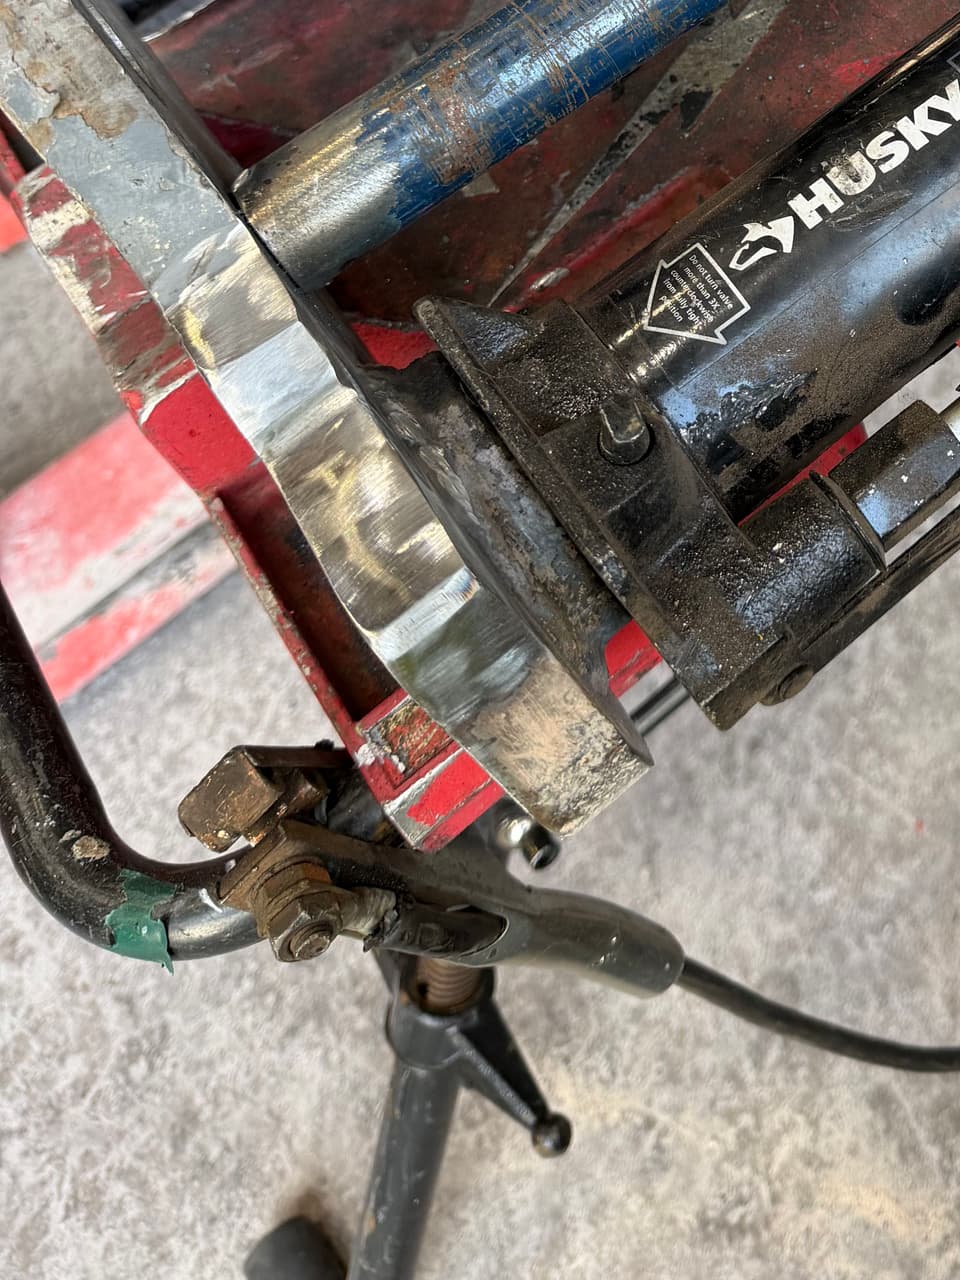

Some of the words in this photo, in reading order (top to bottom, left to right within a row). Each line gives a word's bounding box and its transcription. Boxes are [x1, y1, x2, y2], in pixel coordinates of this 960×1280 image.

[663, 278, 676, 294] from
[670, 270, 714, 323] counterclockwise
[683, 266, 698, 283] more
[697, 282, 710, 300] than
[689, 254, 698, 266] Do
[695, 262, 707, 276] not
[705, 273, 718, 292] turn
[717, 288, 733, 309] valve
